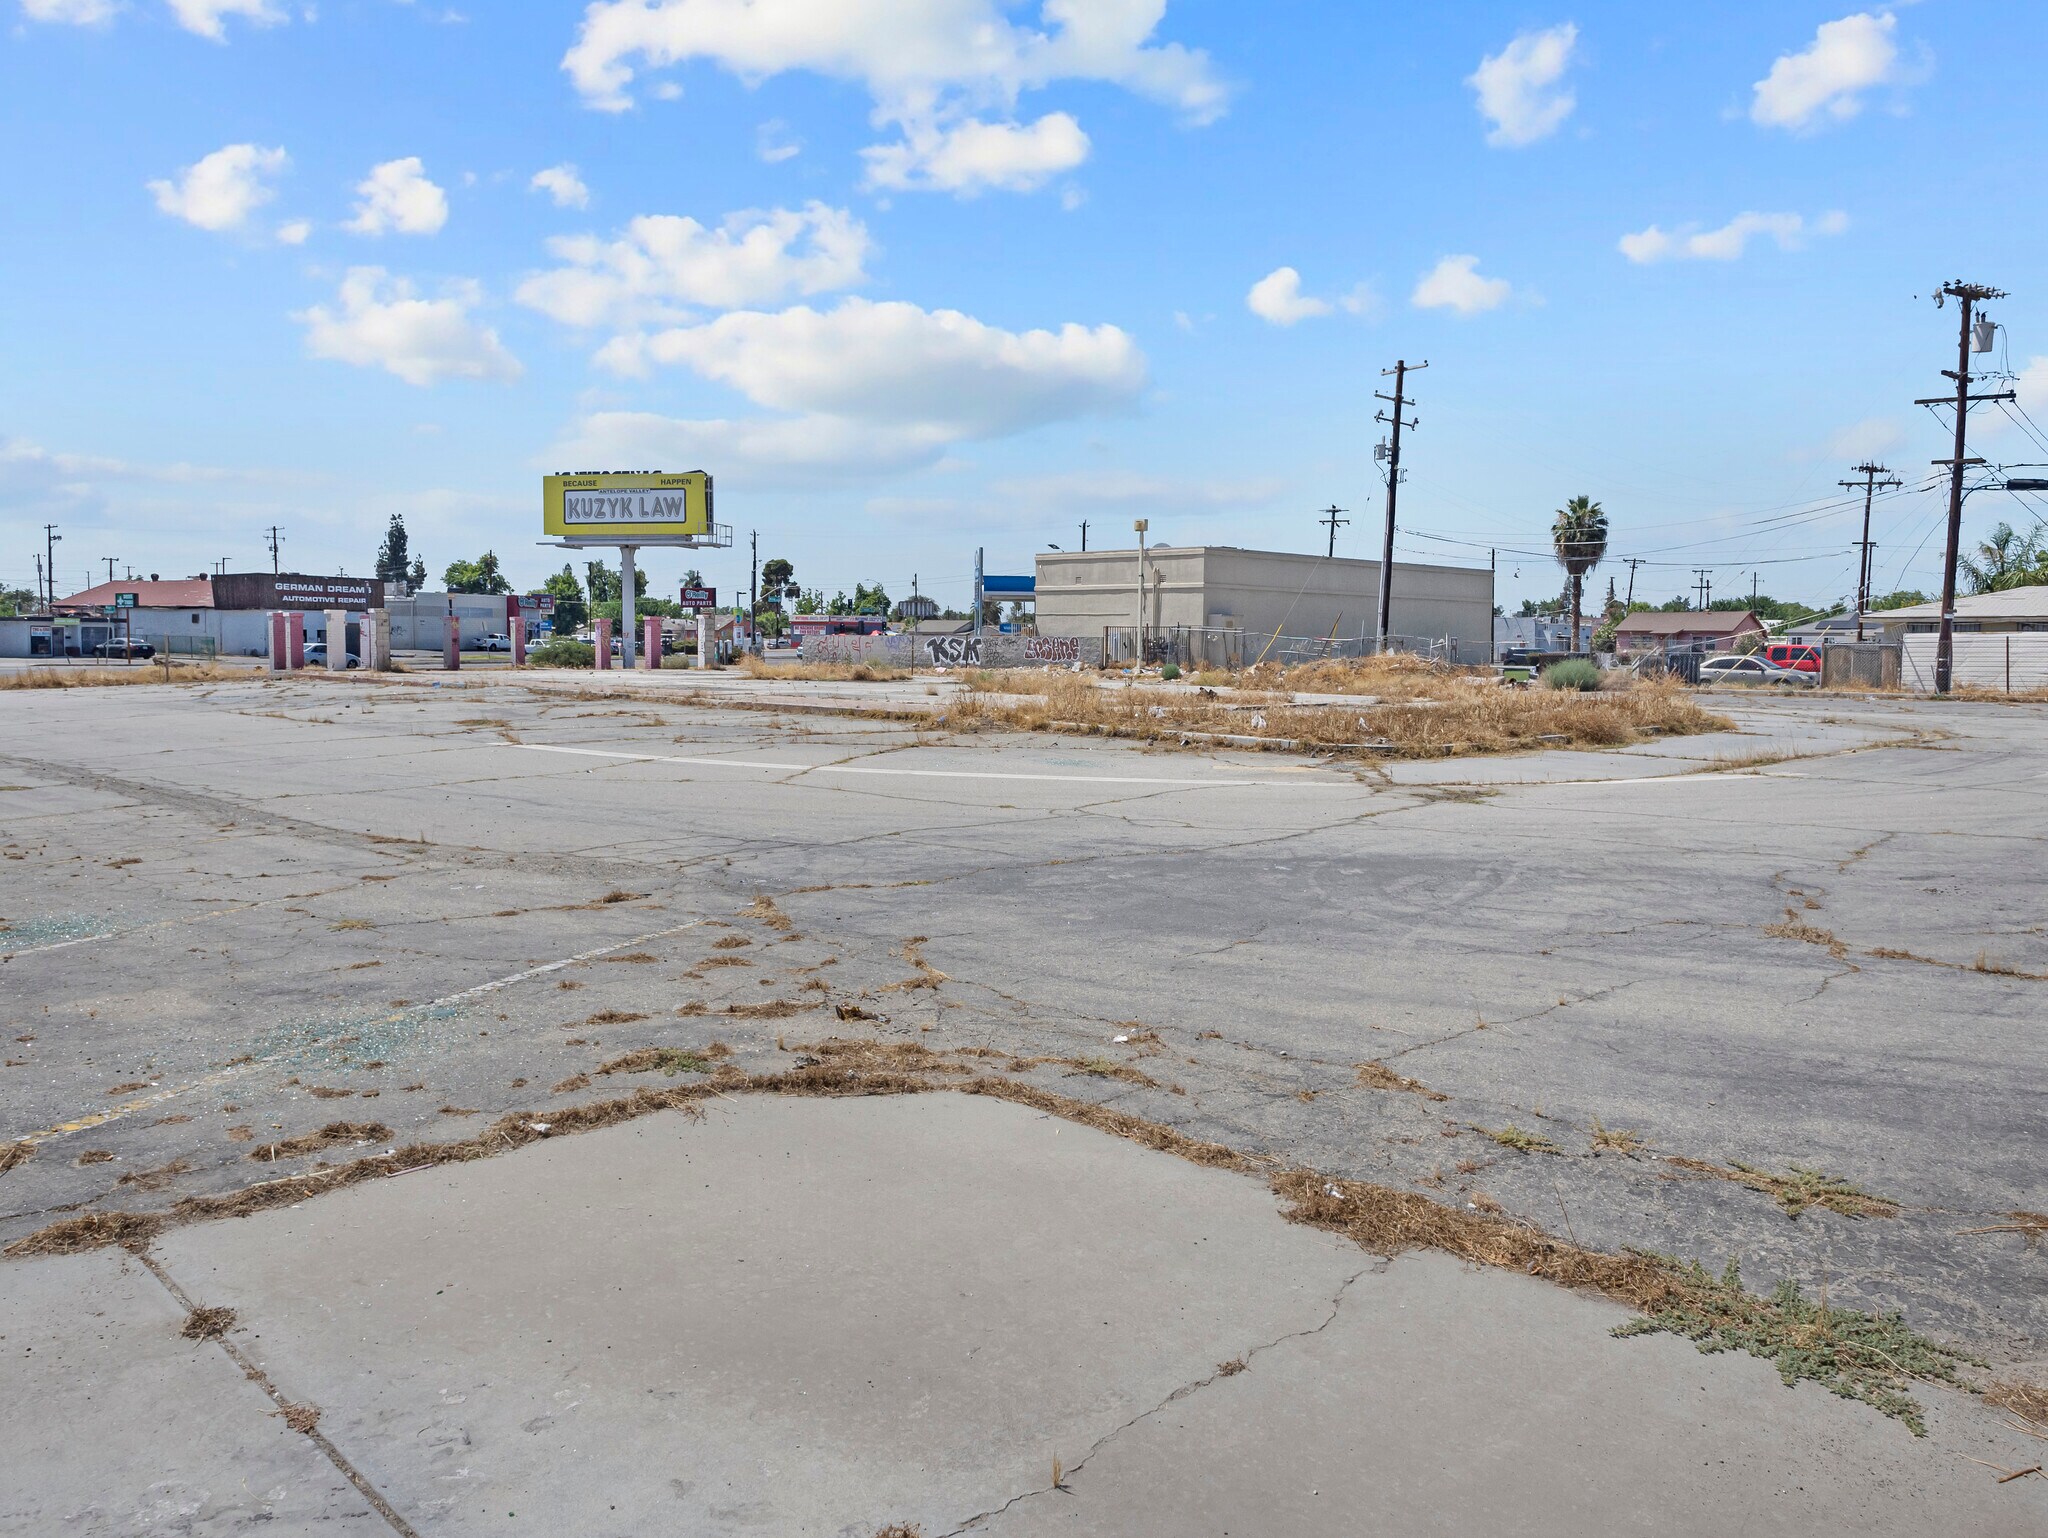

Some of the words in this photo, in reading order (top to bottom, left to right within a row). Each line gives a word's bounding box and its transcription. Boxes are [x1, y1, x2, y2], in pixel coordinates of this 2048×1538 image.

[567, 497, 633, 520] KUZYK
[639, 496, 683, 518] LAW
[275, 583, 323, 592] GERMAN
[282, 595, 336, 603] AUTOMOTIVE
[924, 636, 982, 666] KSK
